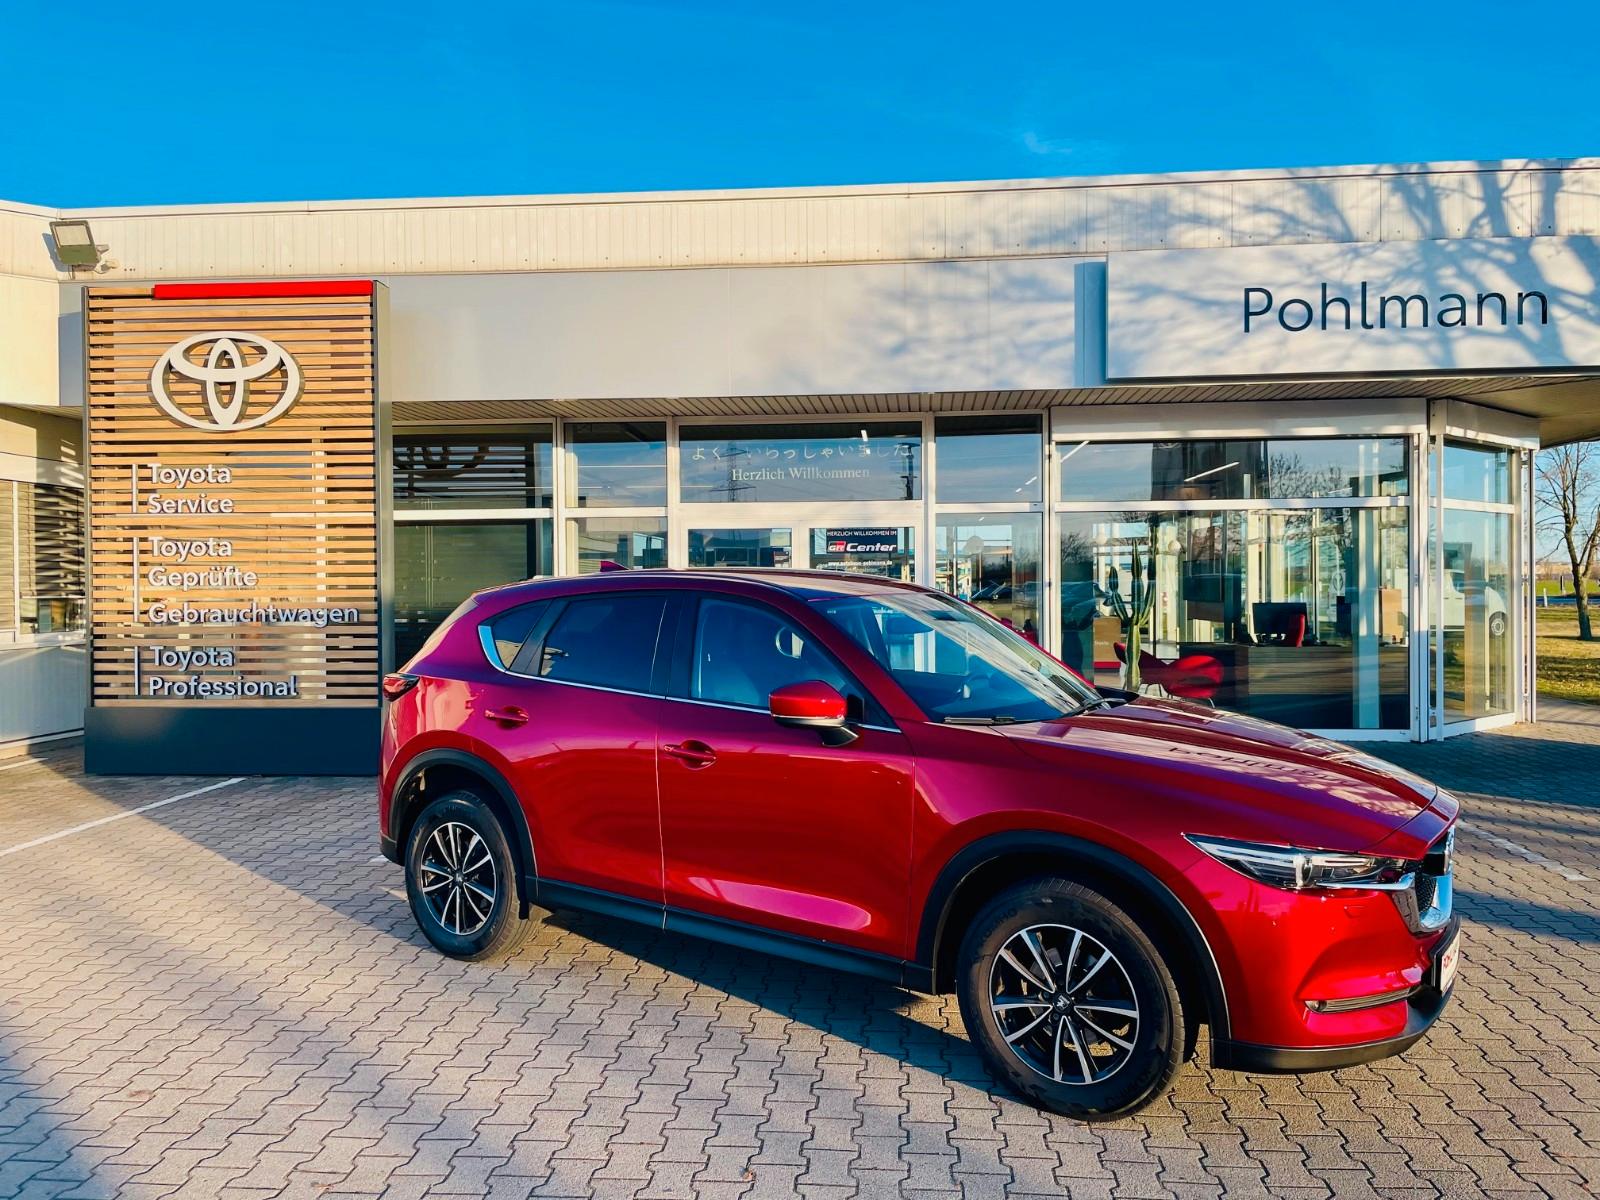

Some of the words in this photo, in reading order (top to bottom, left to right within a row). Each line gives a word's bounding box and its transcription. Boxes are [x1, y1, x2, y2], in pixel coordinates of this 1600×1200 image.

[1243, 281, 1549, 333] Pohlmann
[148, 463, 232, 488] Toyota
[732, 468, 785, 481] Herzlich
[788, 466, 870, 480] Willkommen
[148, 494, 234, 514] Service
[149, 536, 232, 561] Toyota
[846, 543, 897, 552] Center
[148, 566, 258, 591] Geprüfte
[148, 602, 359, 627] Gebrauchtwagen
[150, 645, 234, 671] Toyota
[149, 676, 298, 696] Professional
